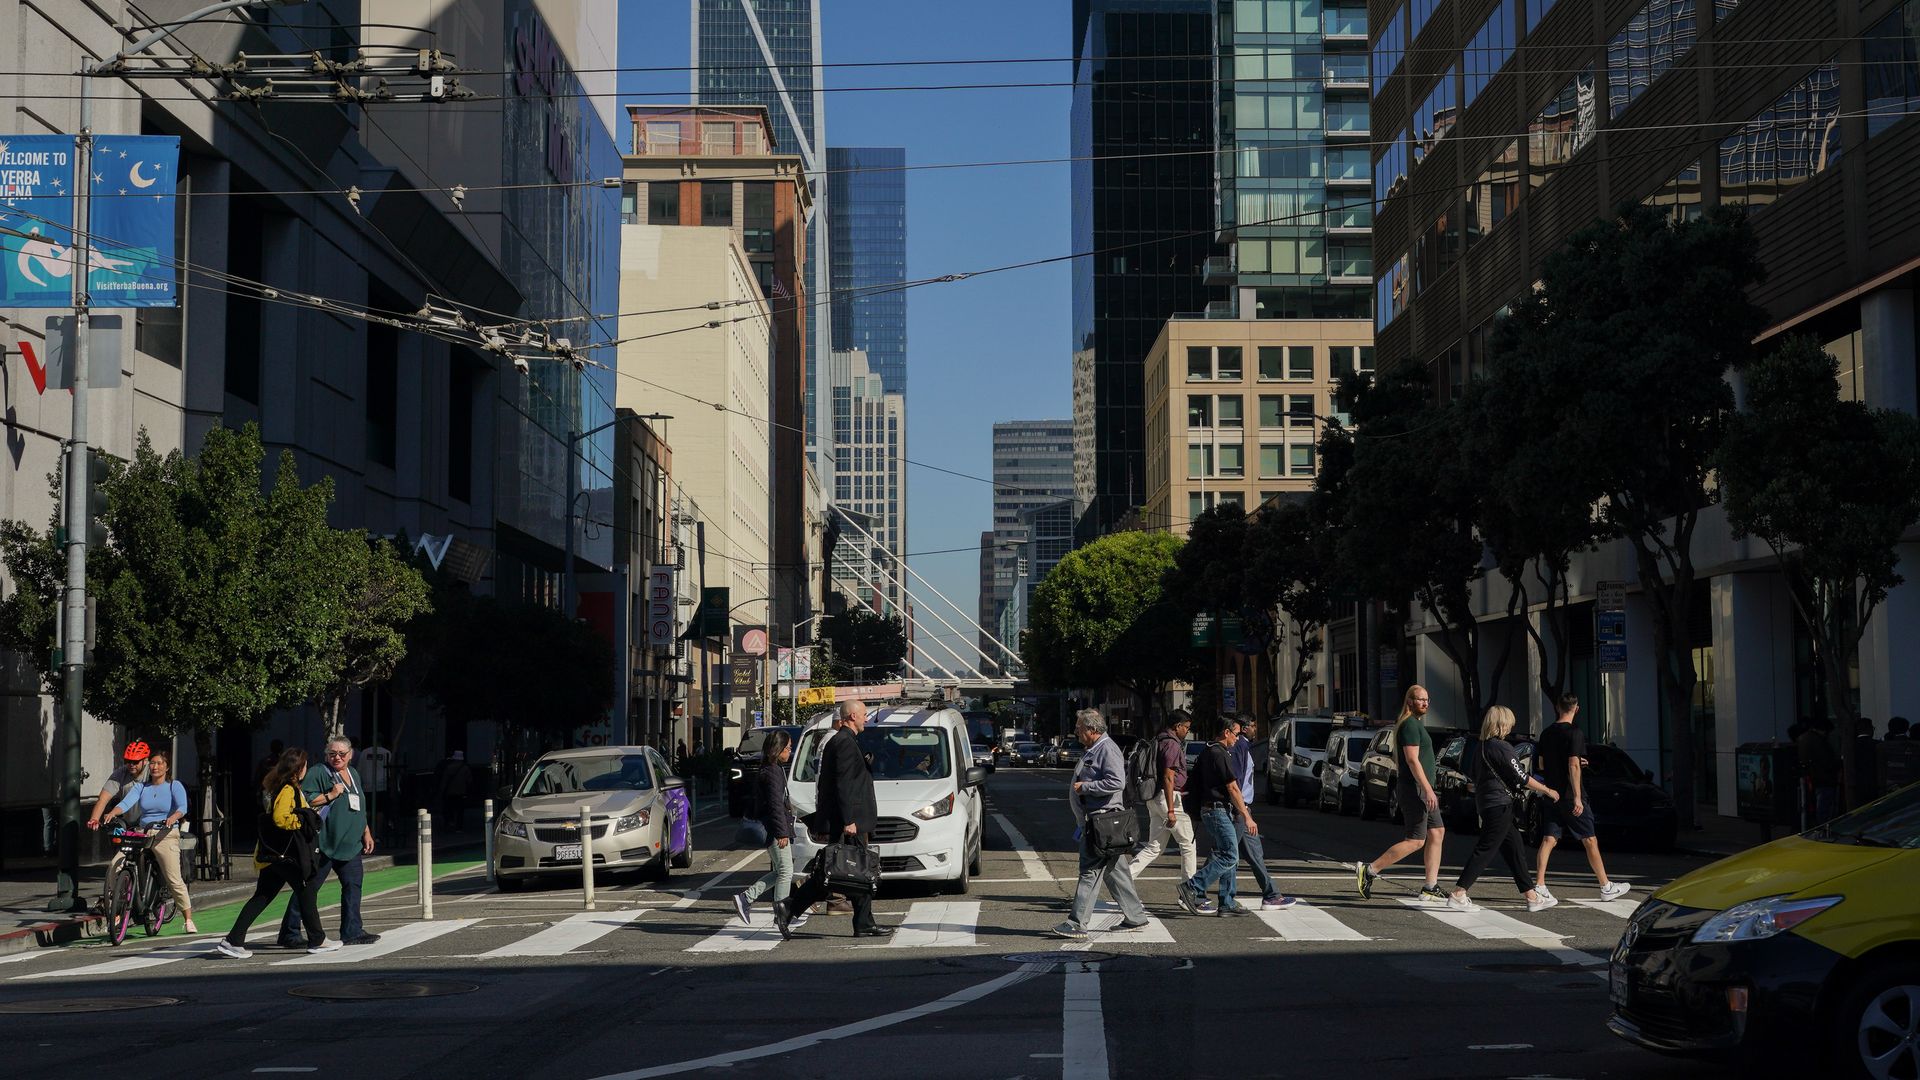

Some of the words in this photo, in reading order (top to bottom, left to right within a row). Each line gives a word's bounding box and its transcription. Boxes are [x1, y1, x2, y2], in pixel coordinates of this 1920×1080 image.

[53, 152, 67, 166] TO
[1, 170, 41, 186] YERBA
[0, 185, 33, 206] UENA
[96, 281, 169, 292] VisitYerbaBuena.org
[653, 572, 670, 638] FANG
